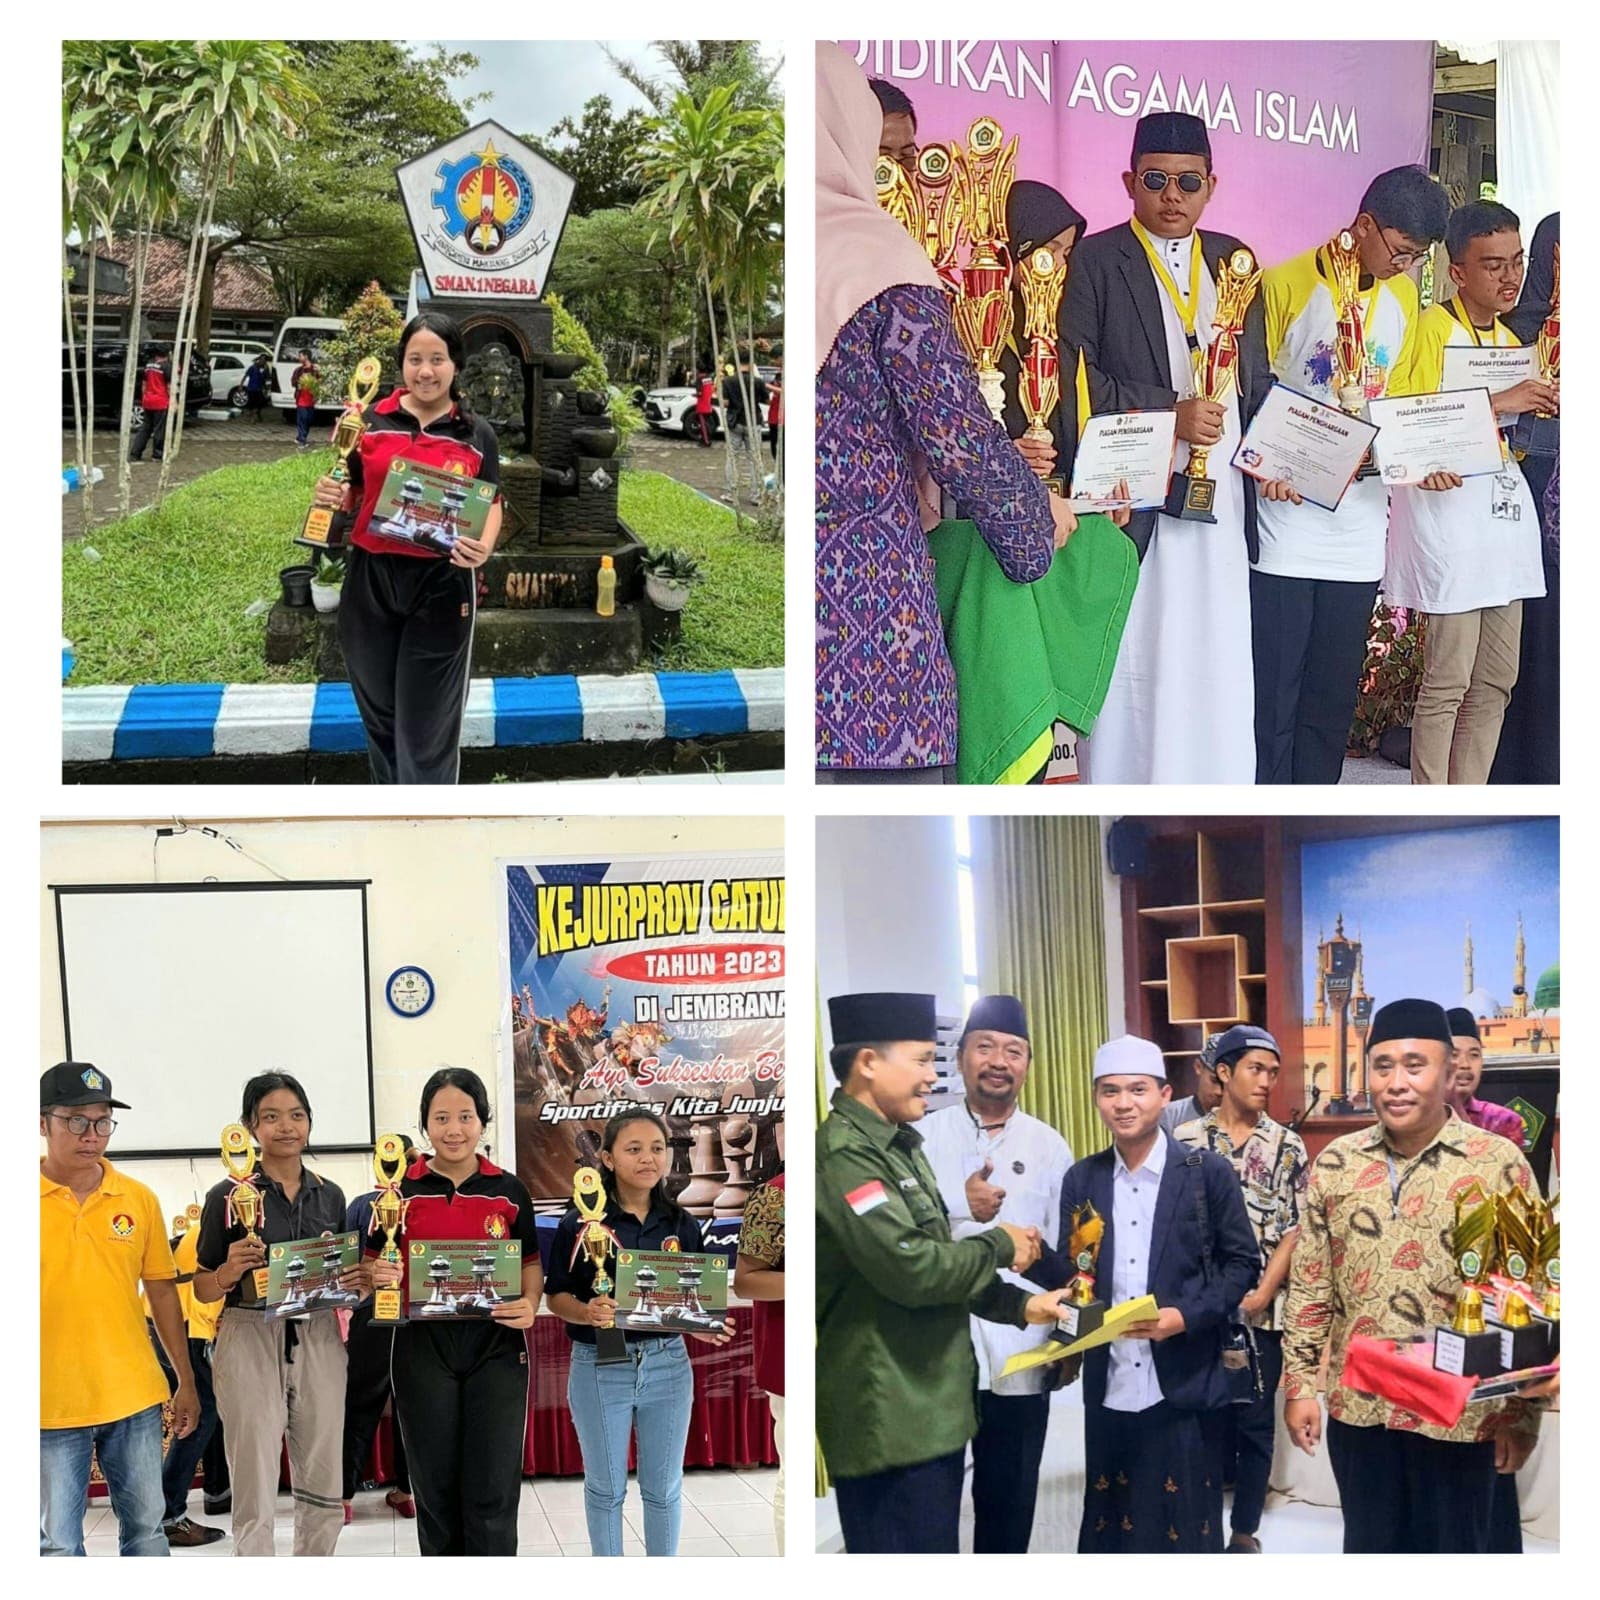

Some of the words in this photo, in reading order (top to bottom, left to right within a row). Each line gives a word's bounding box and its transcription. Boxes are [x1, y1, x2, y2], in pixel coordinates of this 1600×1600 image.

[1067, 57, 1242, 134] AGAMA
[1254, 88, 1360, 154] ISLAM
[537, 881, 703, 956] KEJURPROV
[709, 878, 784, 933] CATU
[644, 951, 716, 978] TAHUN
[724, 949, 782, 974] 2023
[634, 995, 659, 1023] DI
[579, 1056, 629, 1095] Ayo
[634, 1053, 751, 1089] Sukseskan
[669, 1096, 720, 1117] Kita
